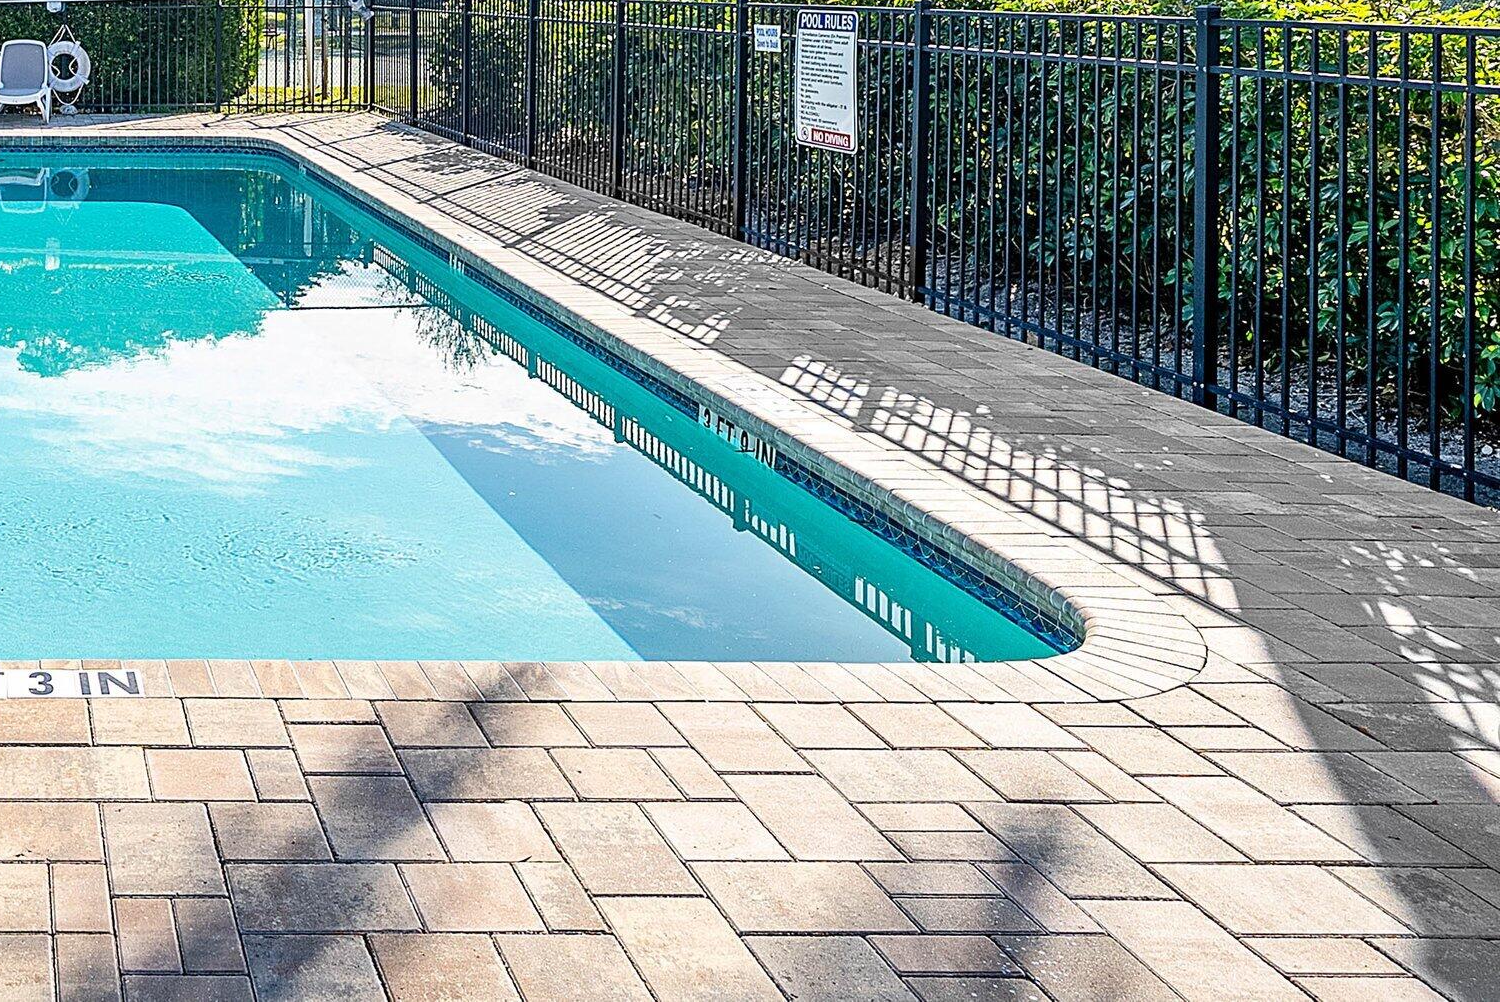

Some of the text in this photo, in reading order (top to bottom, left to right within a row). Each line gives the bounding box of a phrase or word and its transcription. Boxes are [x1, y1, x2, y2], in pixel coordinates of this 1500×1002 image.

[801, 13, 853, 30] POOL RULES
[813, 131, 849, 147] NO DIVING
[703, 406, 711, 428] 3
[716, 415, 735, 443] FT
[755, 438, 774, 468] IN
[27, 670, 55, 696] 3
[78, 670, 140, 696] IN
